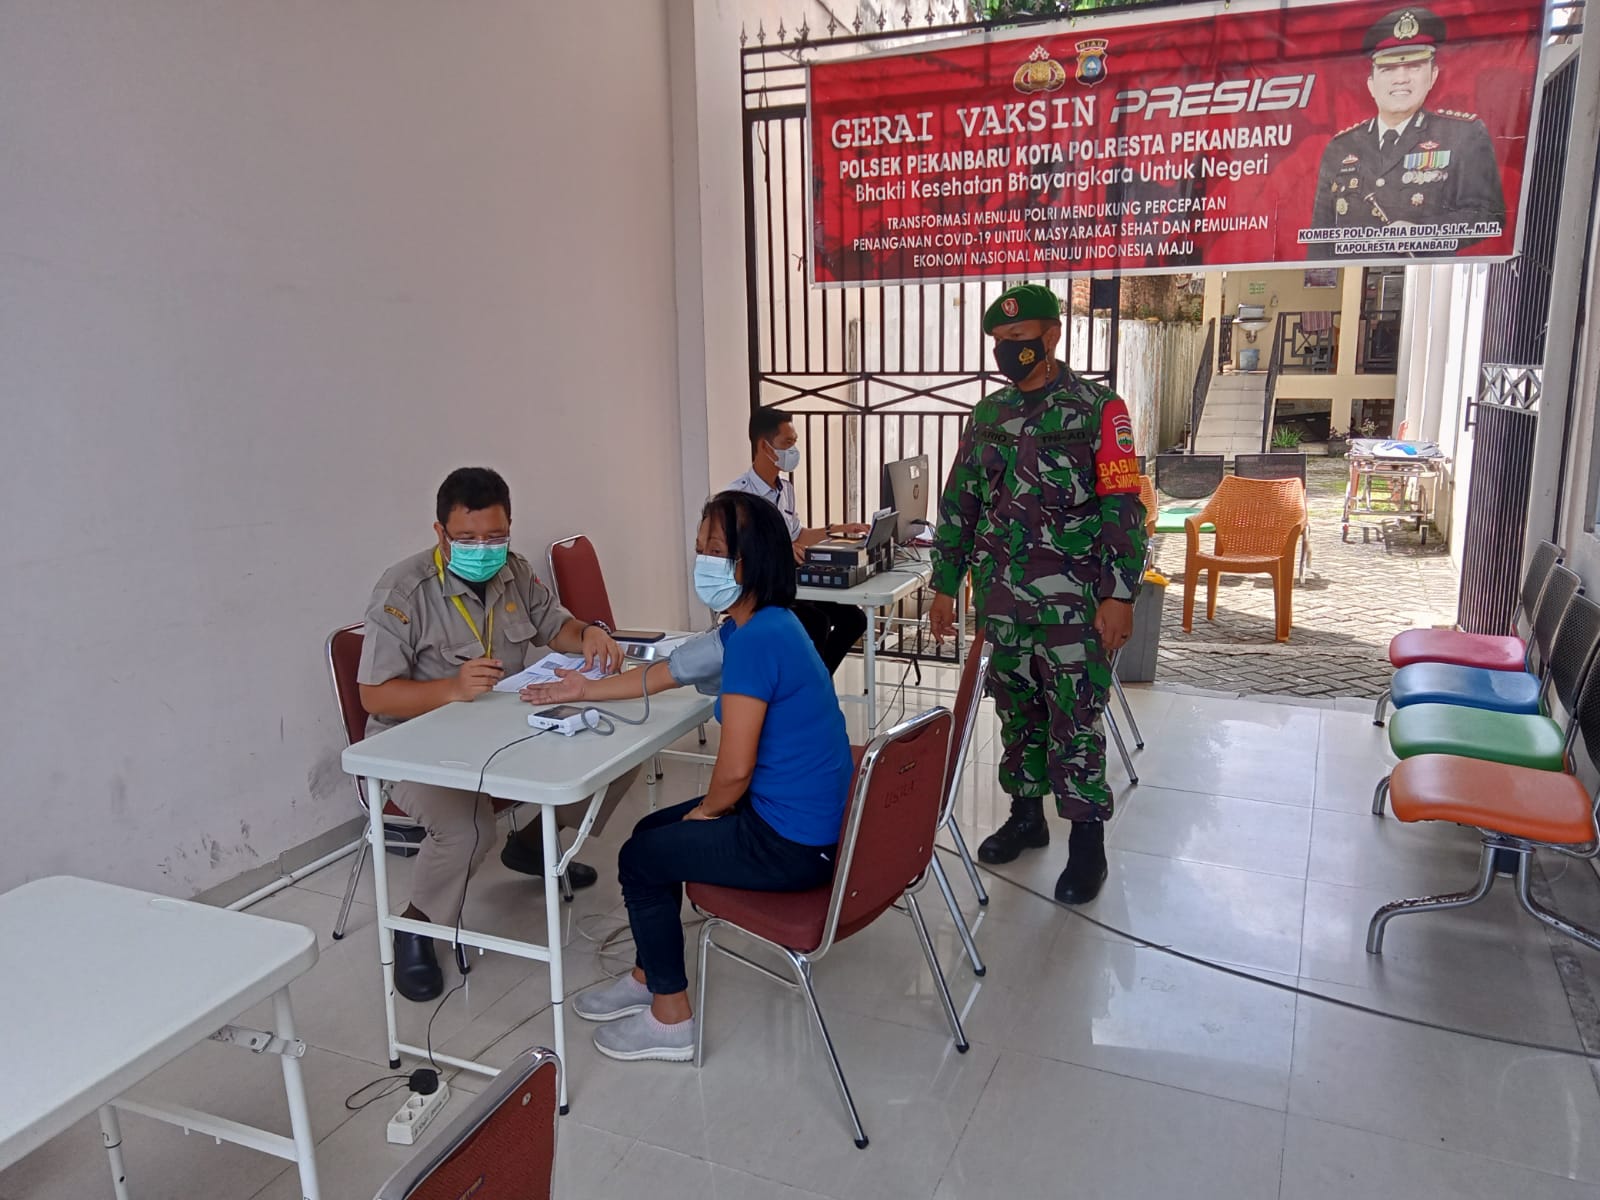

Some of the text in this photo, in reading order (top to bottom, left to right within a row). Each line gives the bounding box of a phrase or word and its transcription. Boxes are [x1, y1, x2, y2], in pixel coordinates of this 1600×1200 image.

[831, 74, 1316, 149] GERAI VAKSIN PRESISI
[839, 124, 1292, 180] POLSEK PEKANBARU KOTA POLRESTA PEKANBARU
[856, 153, 1269, 202] Bhakti Kesehatan Bhayangkara Untuk Negeri
[887, 196, 1227, 231] TRANSFORMASI MENUJU POLRI MENDUKUNG PERCEPATAN
[1299, 229, 1341, 240] KOMBES
[1343, 228, 1364, 238] POL
[1365, 229, 1381, 238] Dr.
[1383, 226, 1407, 237] PRIA
[1410, 225, 1440, 237] BUDI,
[1475, 222, 1501, 234] M.H.
[853, 215, 1269, 252] PENANGANAN COVID-19 UNTUK MASYARAKAT SEHAT DAN PEMULIHAN
[1335, 239, 1457, 253] KAPOLRESTA PEKANBARU
[913, 240, 1194, 268] EKONOMI NASIONAL MENUJU INDONESIA MAJU
